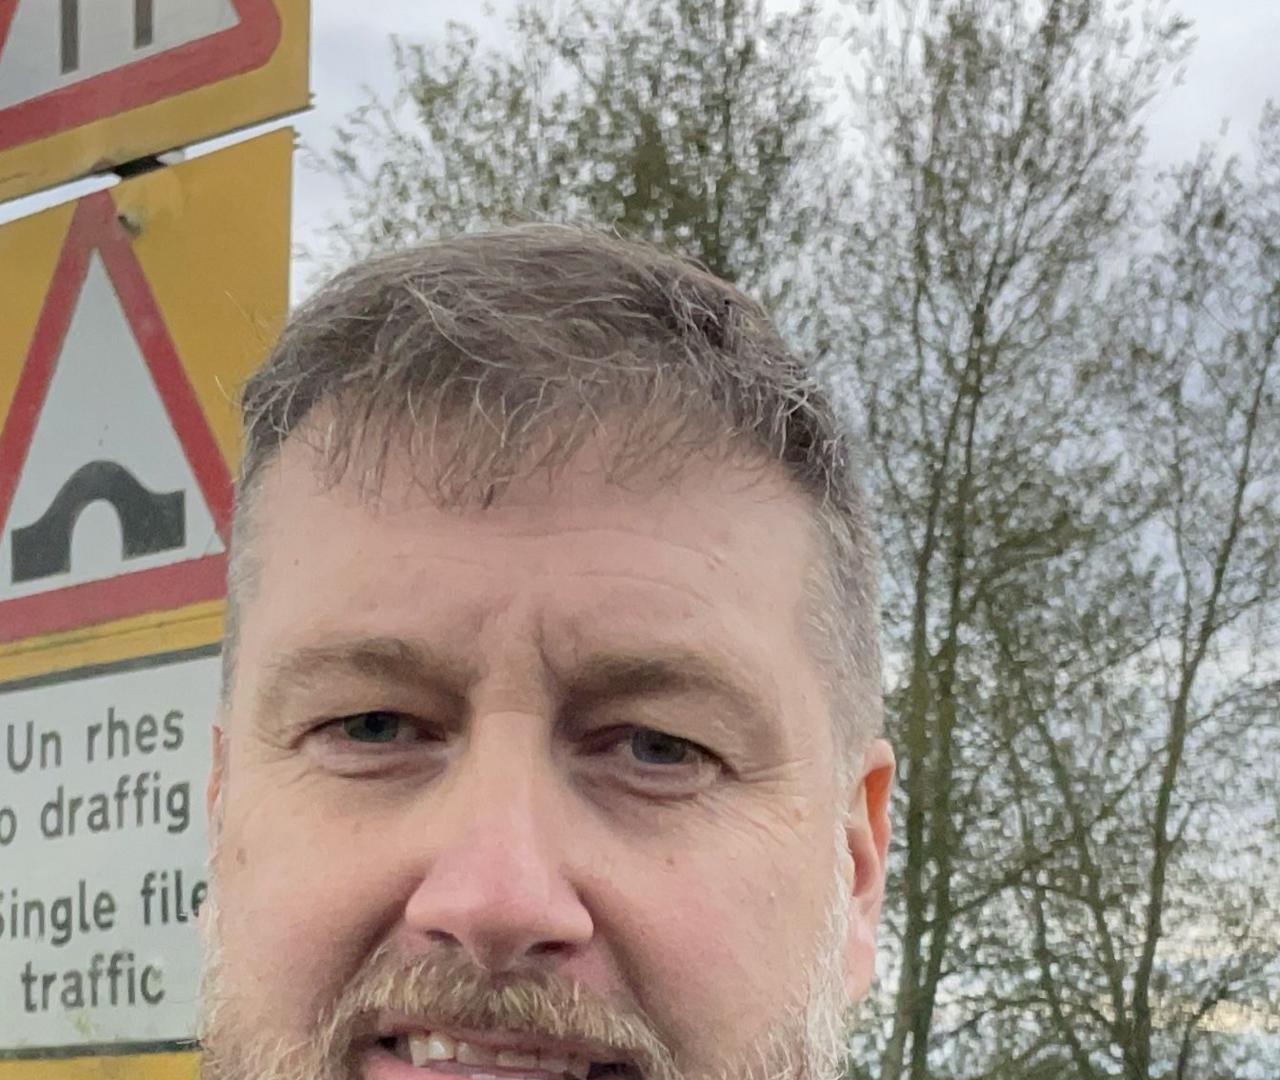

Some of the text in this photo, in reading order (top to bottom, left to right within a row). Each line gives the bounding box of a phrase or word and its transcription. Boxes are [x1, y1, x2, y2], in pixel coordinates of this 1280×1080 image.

[6, 707, 184, 772] Un rhes
[40, 772, 191, 839] draffig
[21, 952, 166, 1013] traffic
